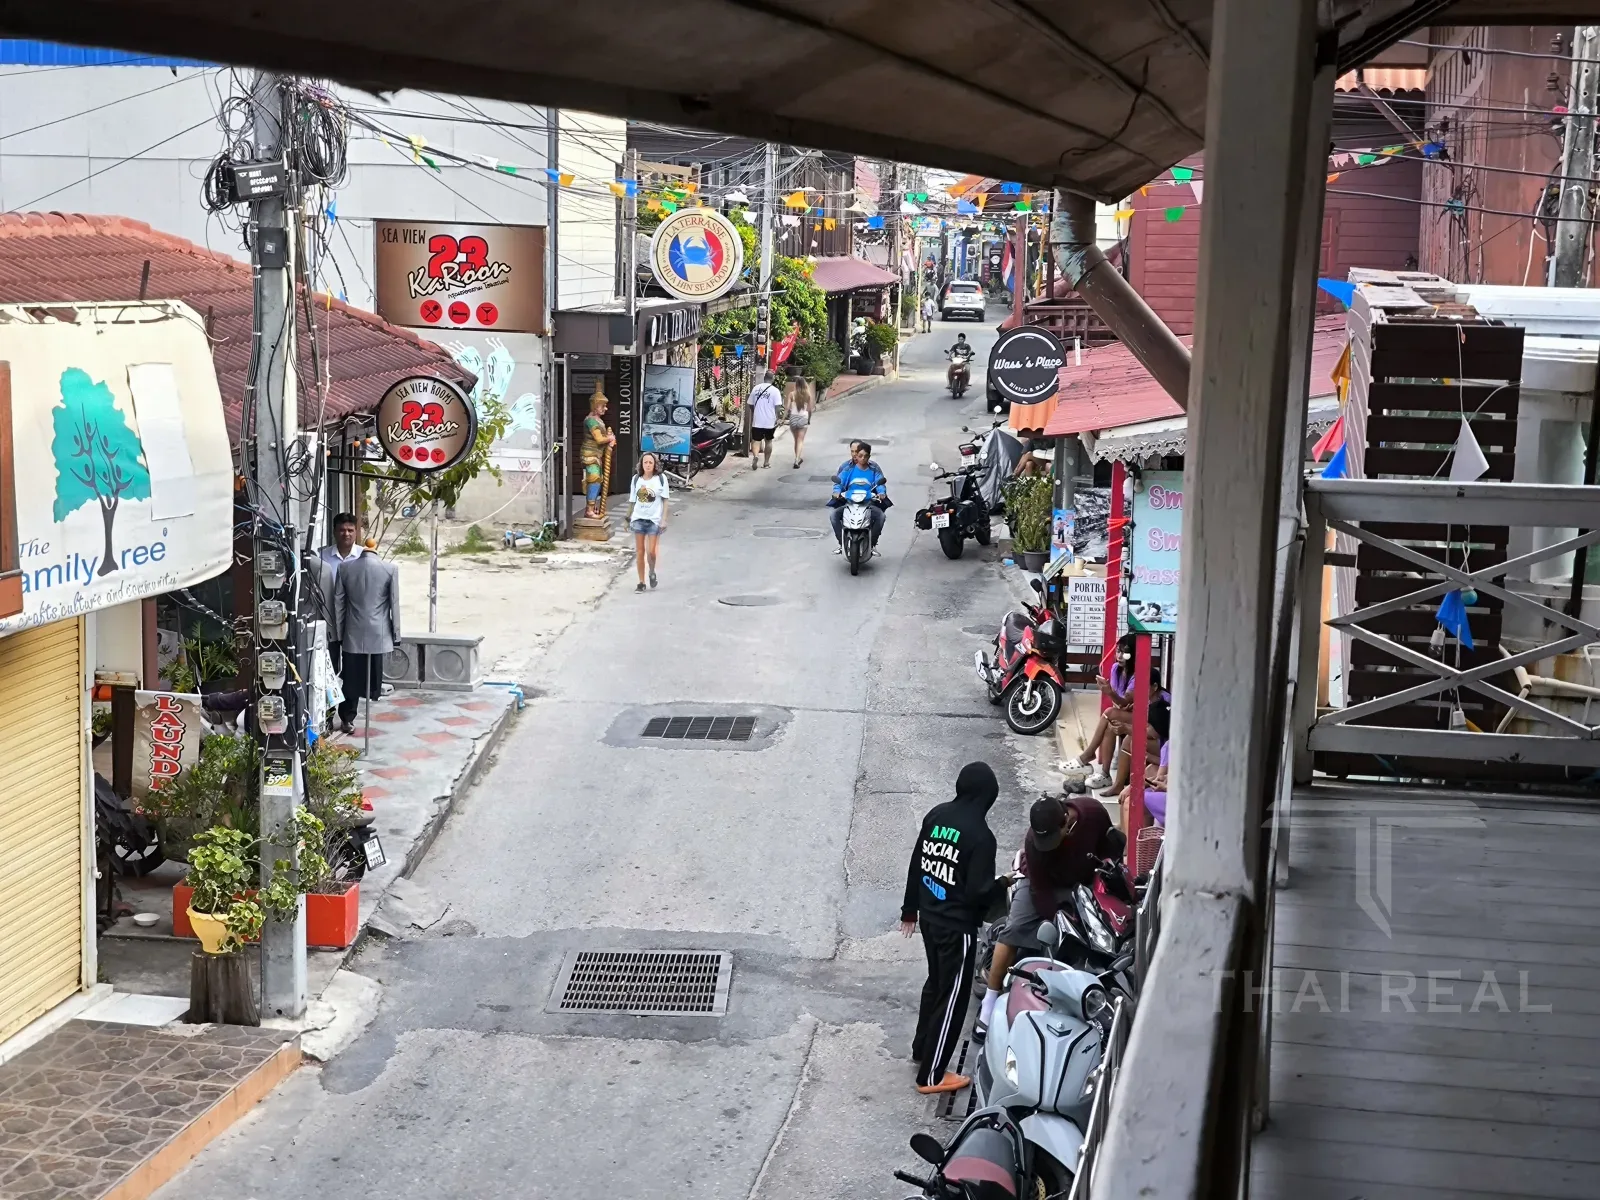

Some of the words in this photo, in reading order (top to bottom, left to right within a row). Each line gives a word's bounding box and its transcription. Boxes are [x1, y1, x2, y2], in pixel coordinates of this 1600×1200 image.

[382, 228, 398, 243] SEA
[403, 229, 426, 244] VIEW
[666, 226, 679, 238] LA
[678, 217, 726, 240] TERRASSE
[428, 234, 488, 279] 23
[662, 266, 678, 284] HUA
[676, 282, 694, 290] HIN
[695, 265, 728, 292] SEAFOOD
[994, 359, 1023, 370] Wass
[1035, 356, 1062, 368] Place
[396, 386, 410, 400] SEA
[410, 382, 428, 394] VIEW
[431, 384, 454, 405] ROOMS
[1009, 382, 1028, 392] Bistro
[1036, 382, 1046, 390] Bar
[401, 401, 444, 430] 23
[620, 410, 631, 434] BAR
[20, 538, 50, 558] The
[106, 579, 124, 603] and
[126, 572, 178, 596] community
[149, 694, 186, 798] LAUND
[267, 774, 288, 785] 599
[930, 826, 960, 843] ANTI
[922, 840, 960, 864] SOCIAL
[921, 856, 956, 886] SOCIAL
[922, 876, 946, 900] CLUB
